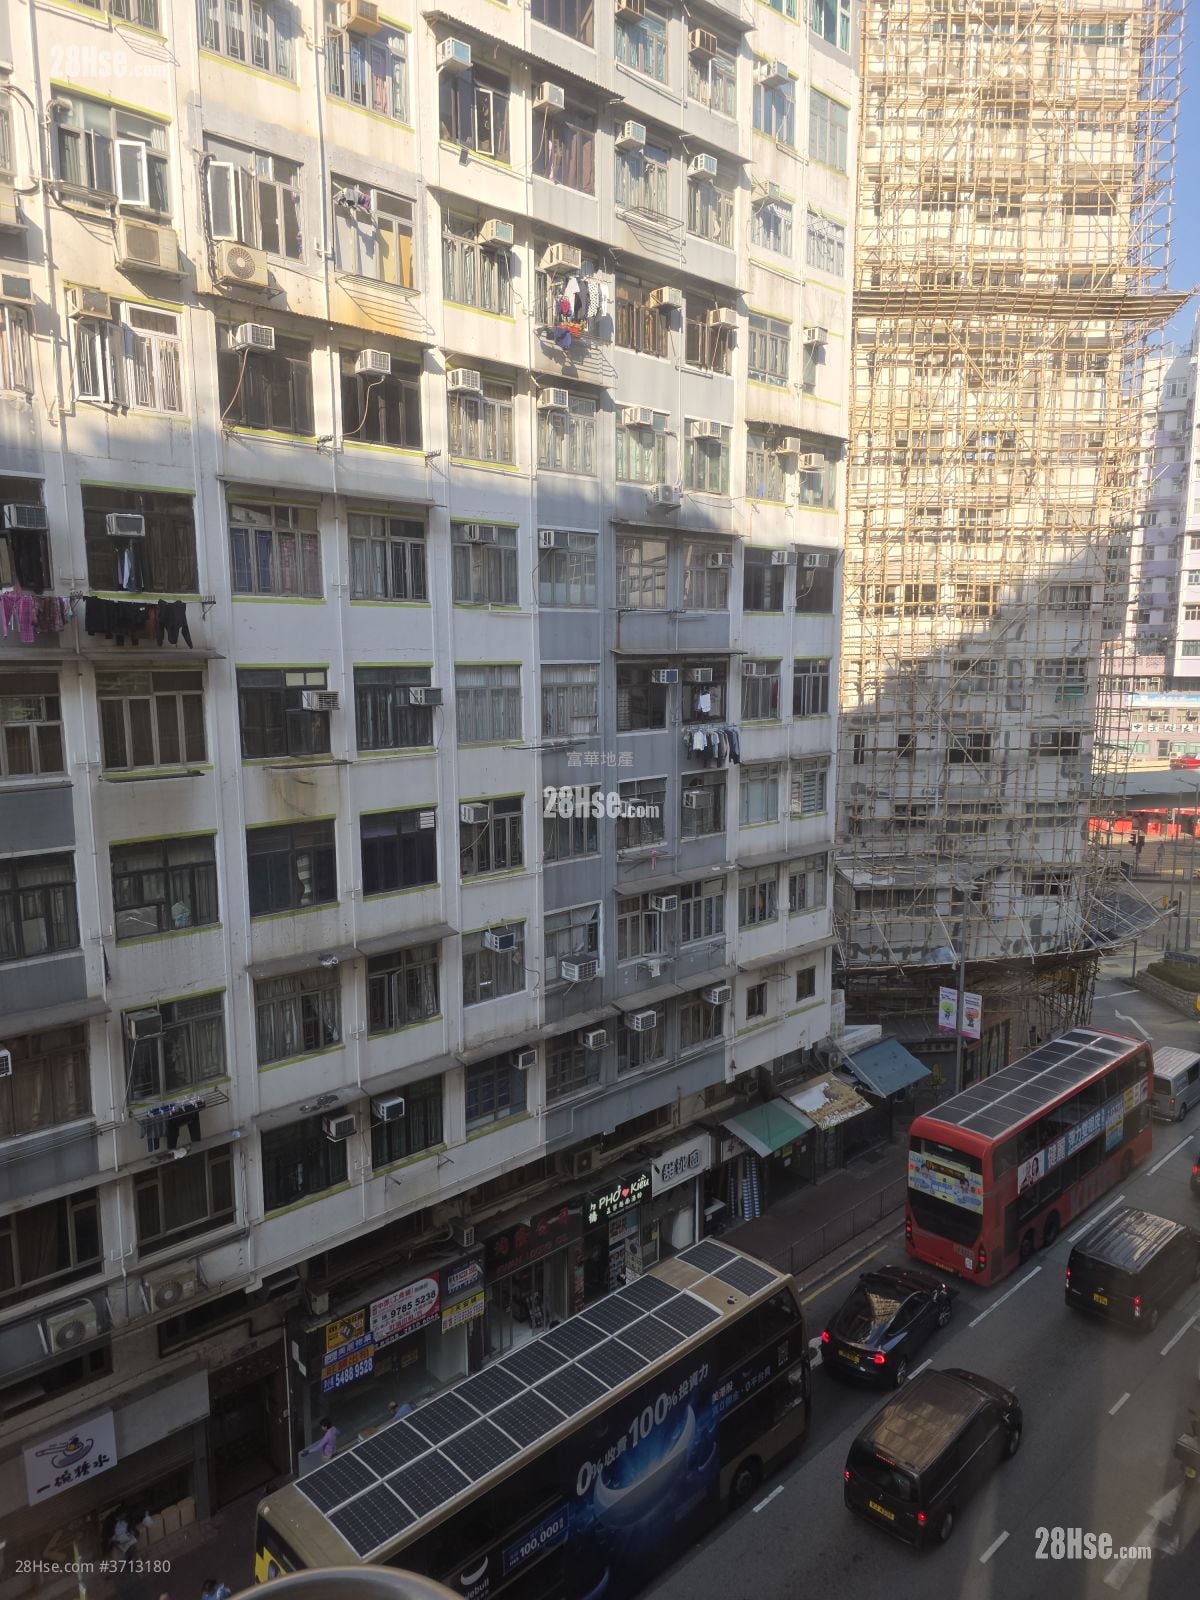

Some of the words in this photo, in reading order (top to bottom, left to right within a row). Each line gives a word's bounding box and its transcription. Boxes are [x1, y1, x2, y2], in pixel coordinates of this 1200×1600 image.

[390, 1302, 413, 1318] 9785
[415, 1290, 436, 1307] 5238
[335, 1366, 354, 1387] 5488
[354, 1357, 373, 1378] 9528
[36, 1454, 110, 1494] 一碗糖水
[520, 1521, 559, 1557] 100,000
